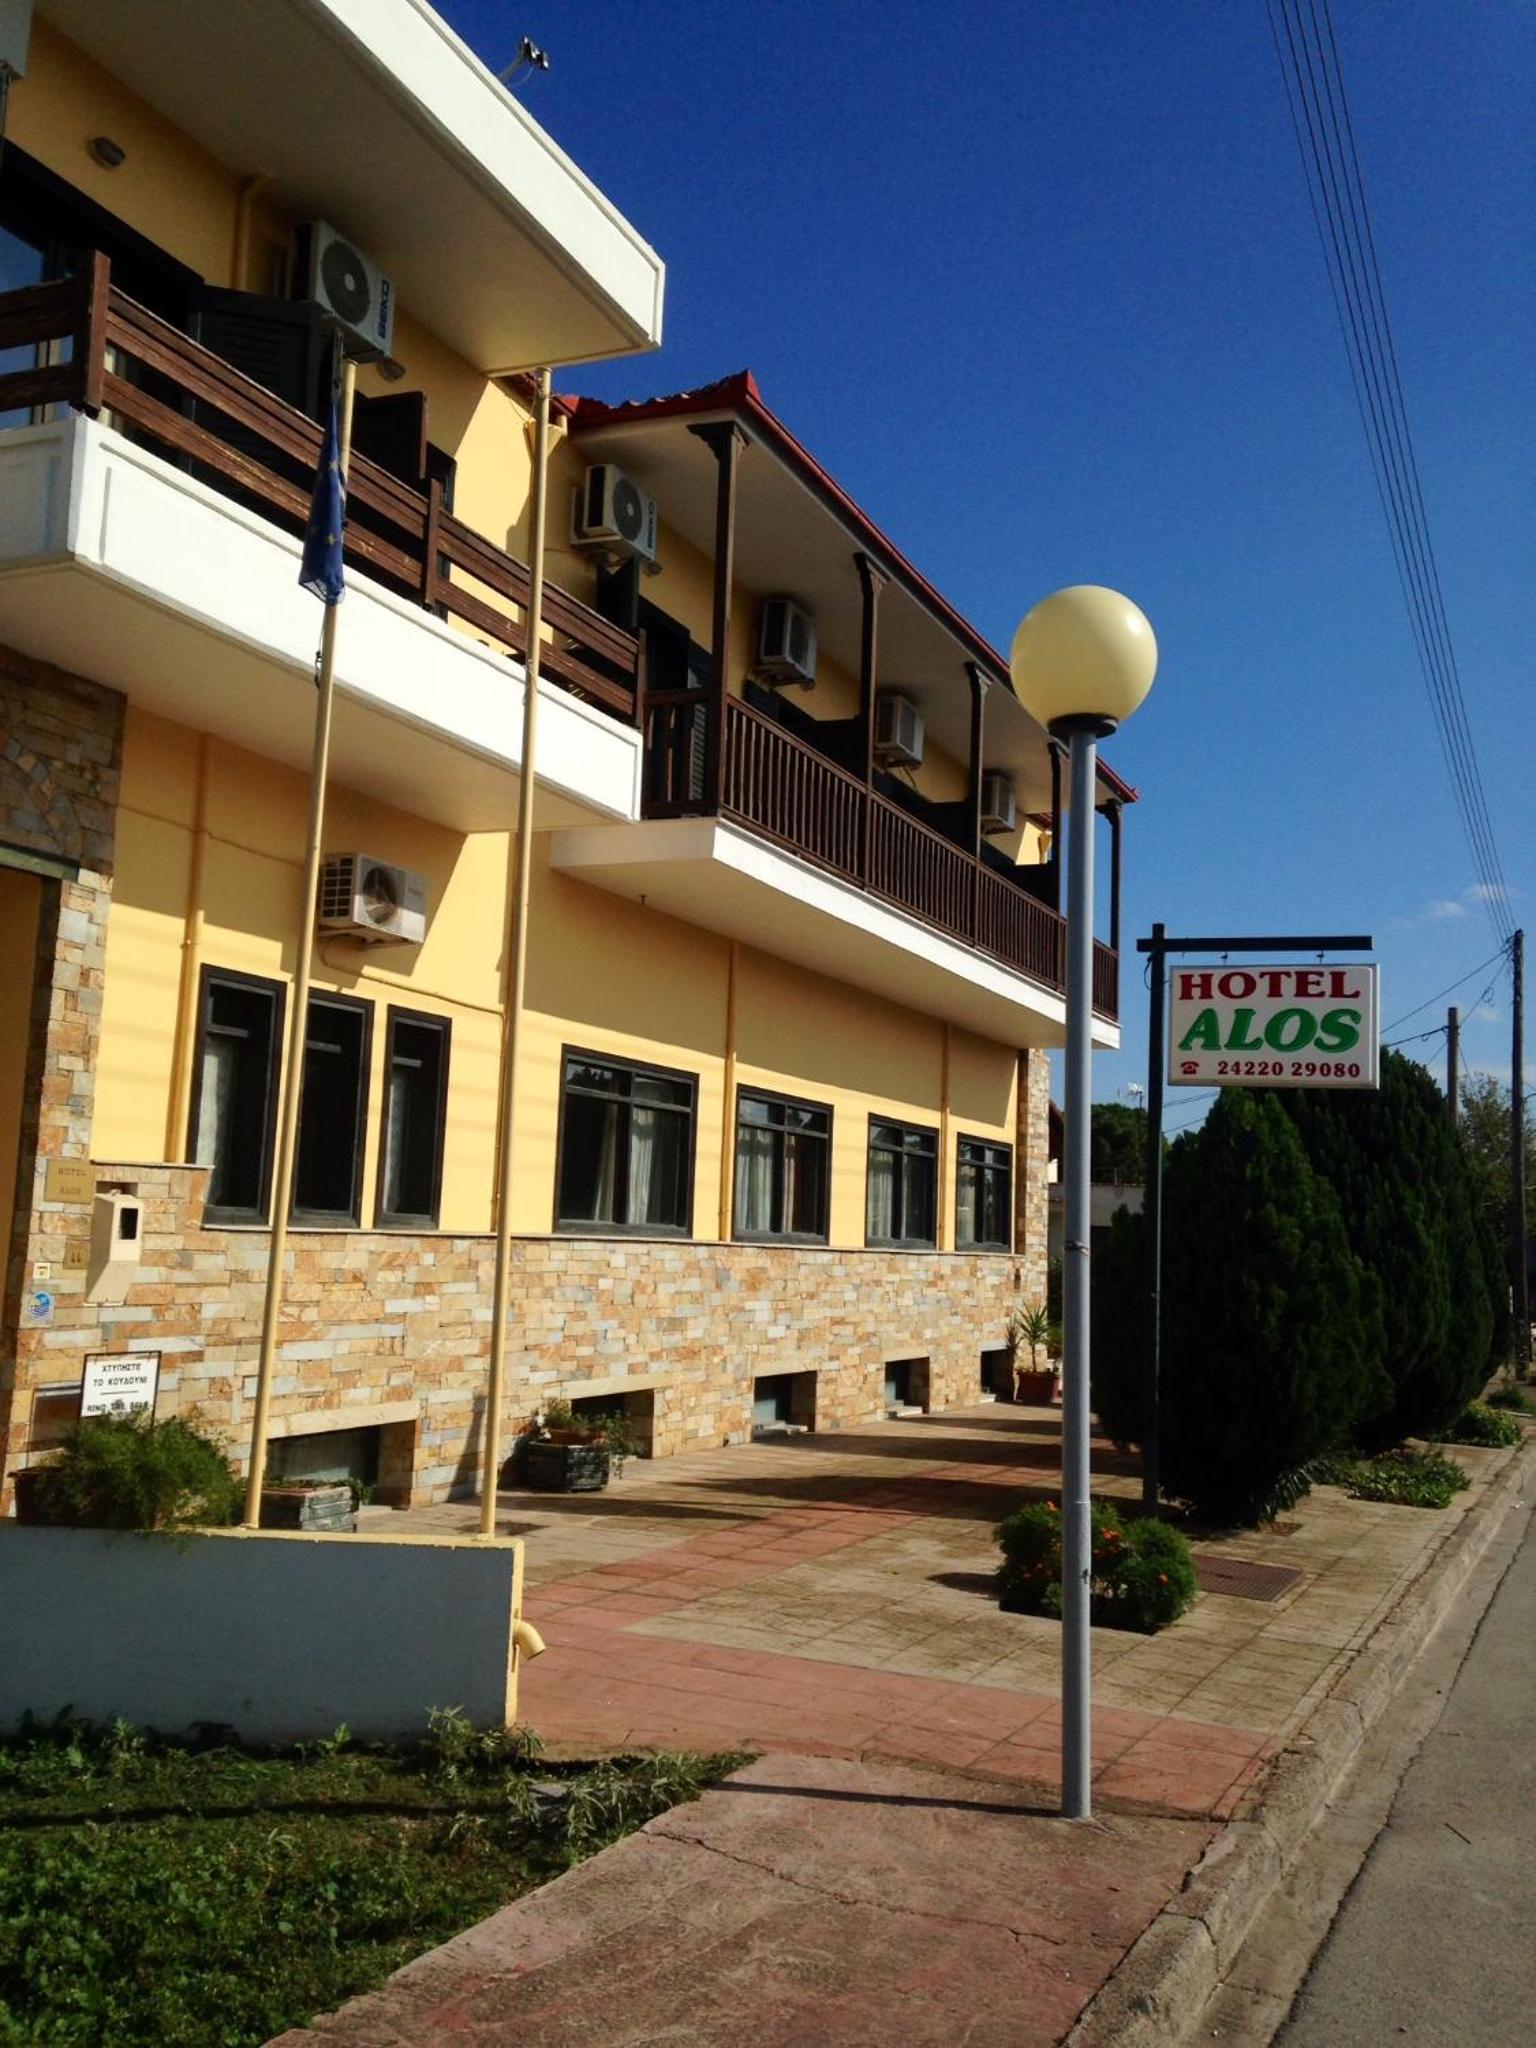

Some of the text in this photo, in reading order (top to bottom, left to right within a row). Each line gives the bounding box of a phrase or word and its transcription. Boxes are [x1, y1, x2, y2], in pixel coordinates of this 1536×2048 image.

[1179, 971, 1361, 1000] HOTEL
[1178, 1008, 1362, 1053] ALOS
[1217, 1060, 1360, 1078] 24220 29080
